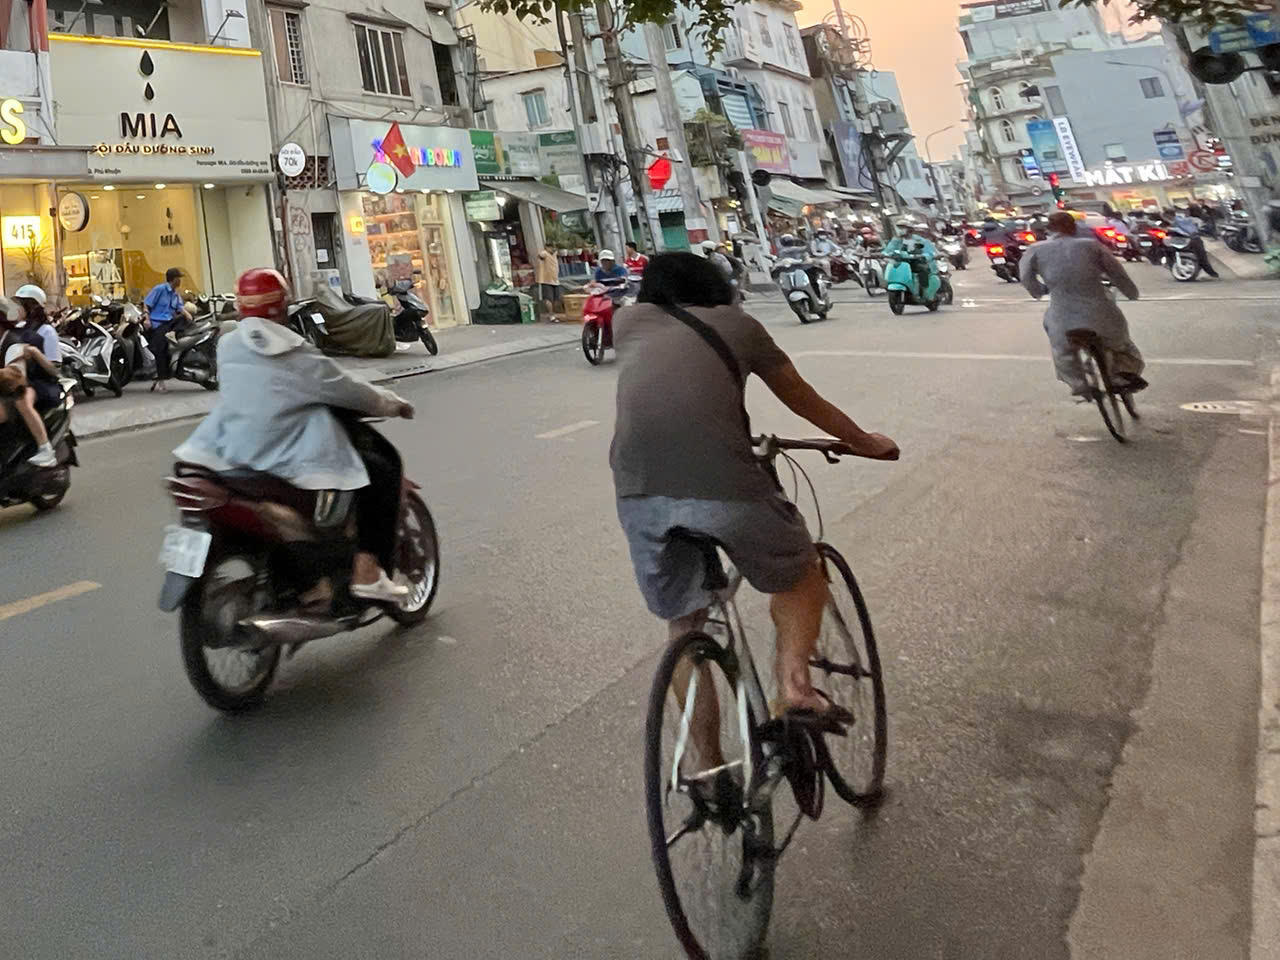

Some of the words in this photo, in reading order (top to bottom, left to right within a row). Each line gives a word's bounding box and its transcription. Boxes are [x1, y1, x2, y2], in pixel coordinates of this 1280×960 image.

[120, 112, 183, 138] MIA
[190, 146, 215, 155] SINH
[11, 224, 34, 240] 415
[160, 234, 182, 246] MIA
